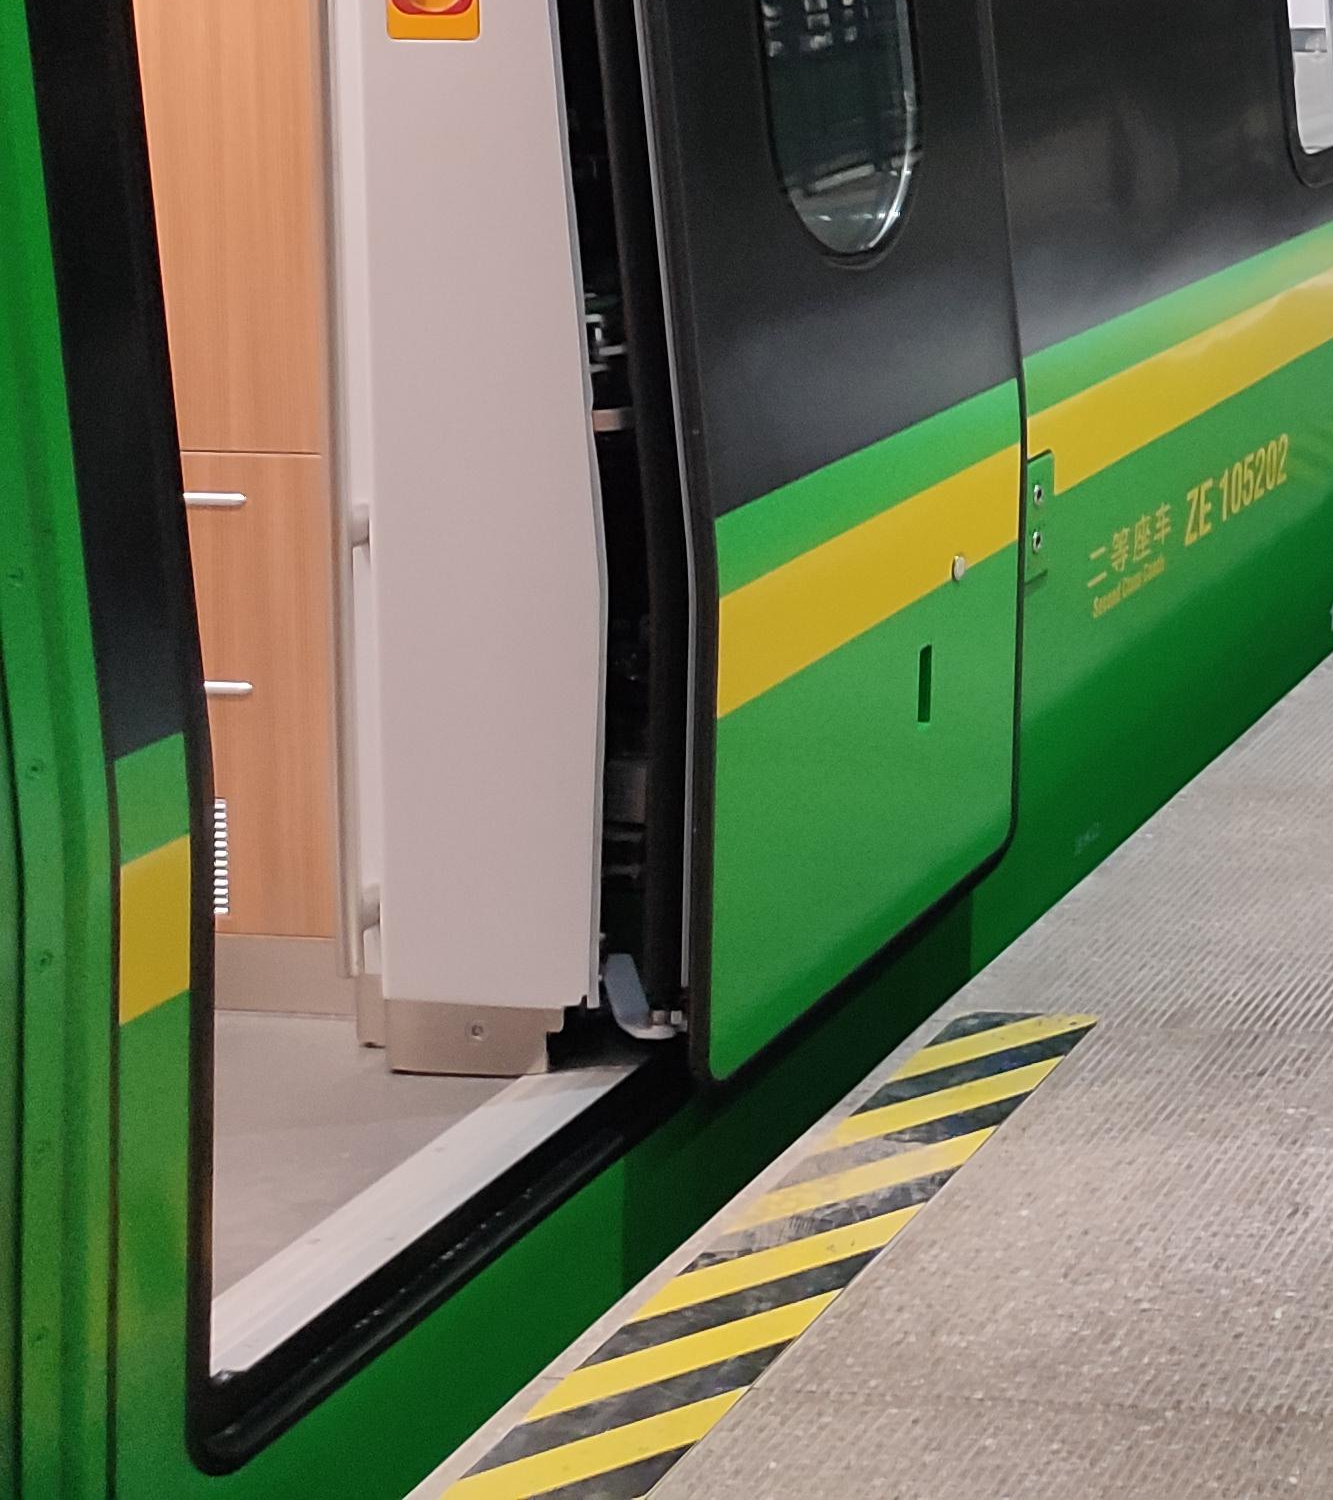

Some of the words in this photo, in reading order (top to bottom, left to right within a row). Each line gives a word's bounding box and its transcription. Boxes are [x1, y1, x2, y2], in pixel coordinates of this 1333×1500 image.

[1184, 478, 1213, 547] ZE
[1219, 433, 1288, 521] 105202
[1087, 502, 1171, 588] 二等座车
